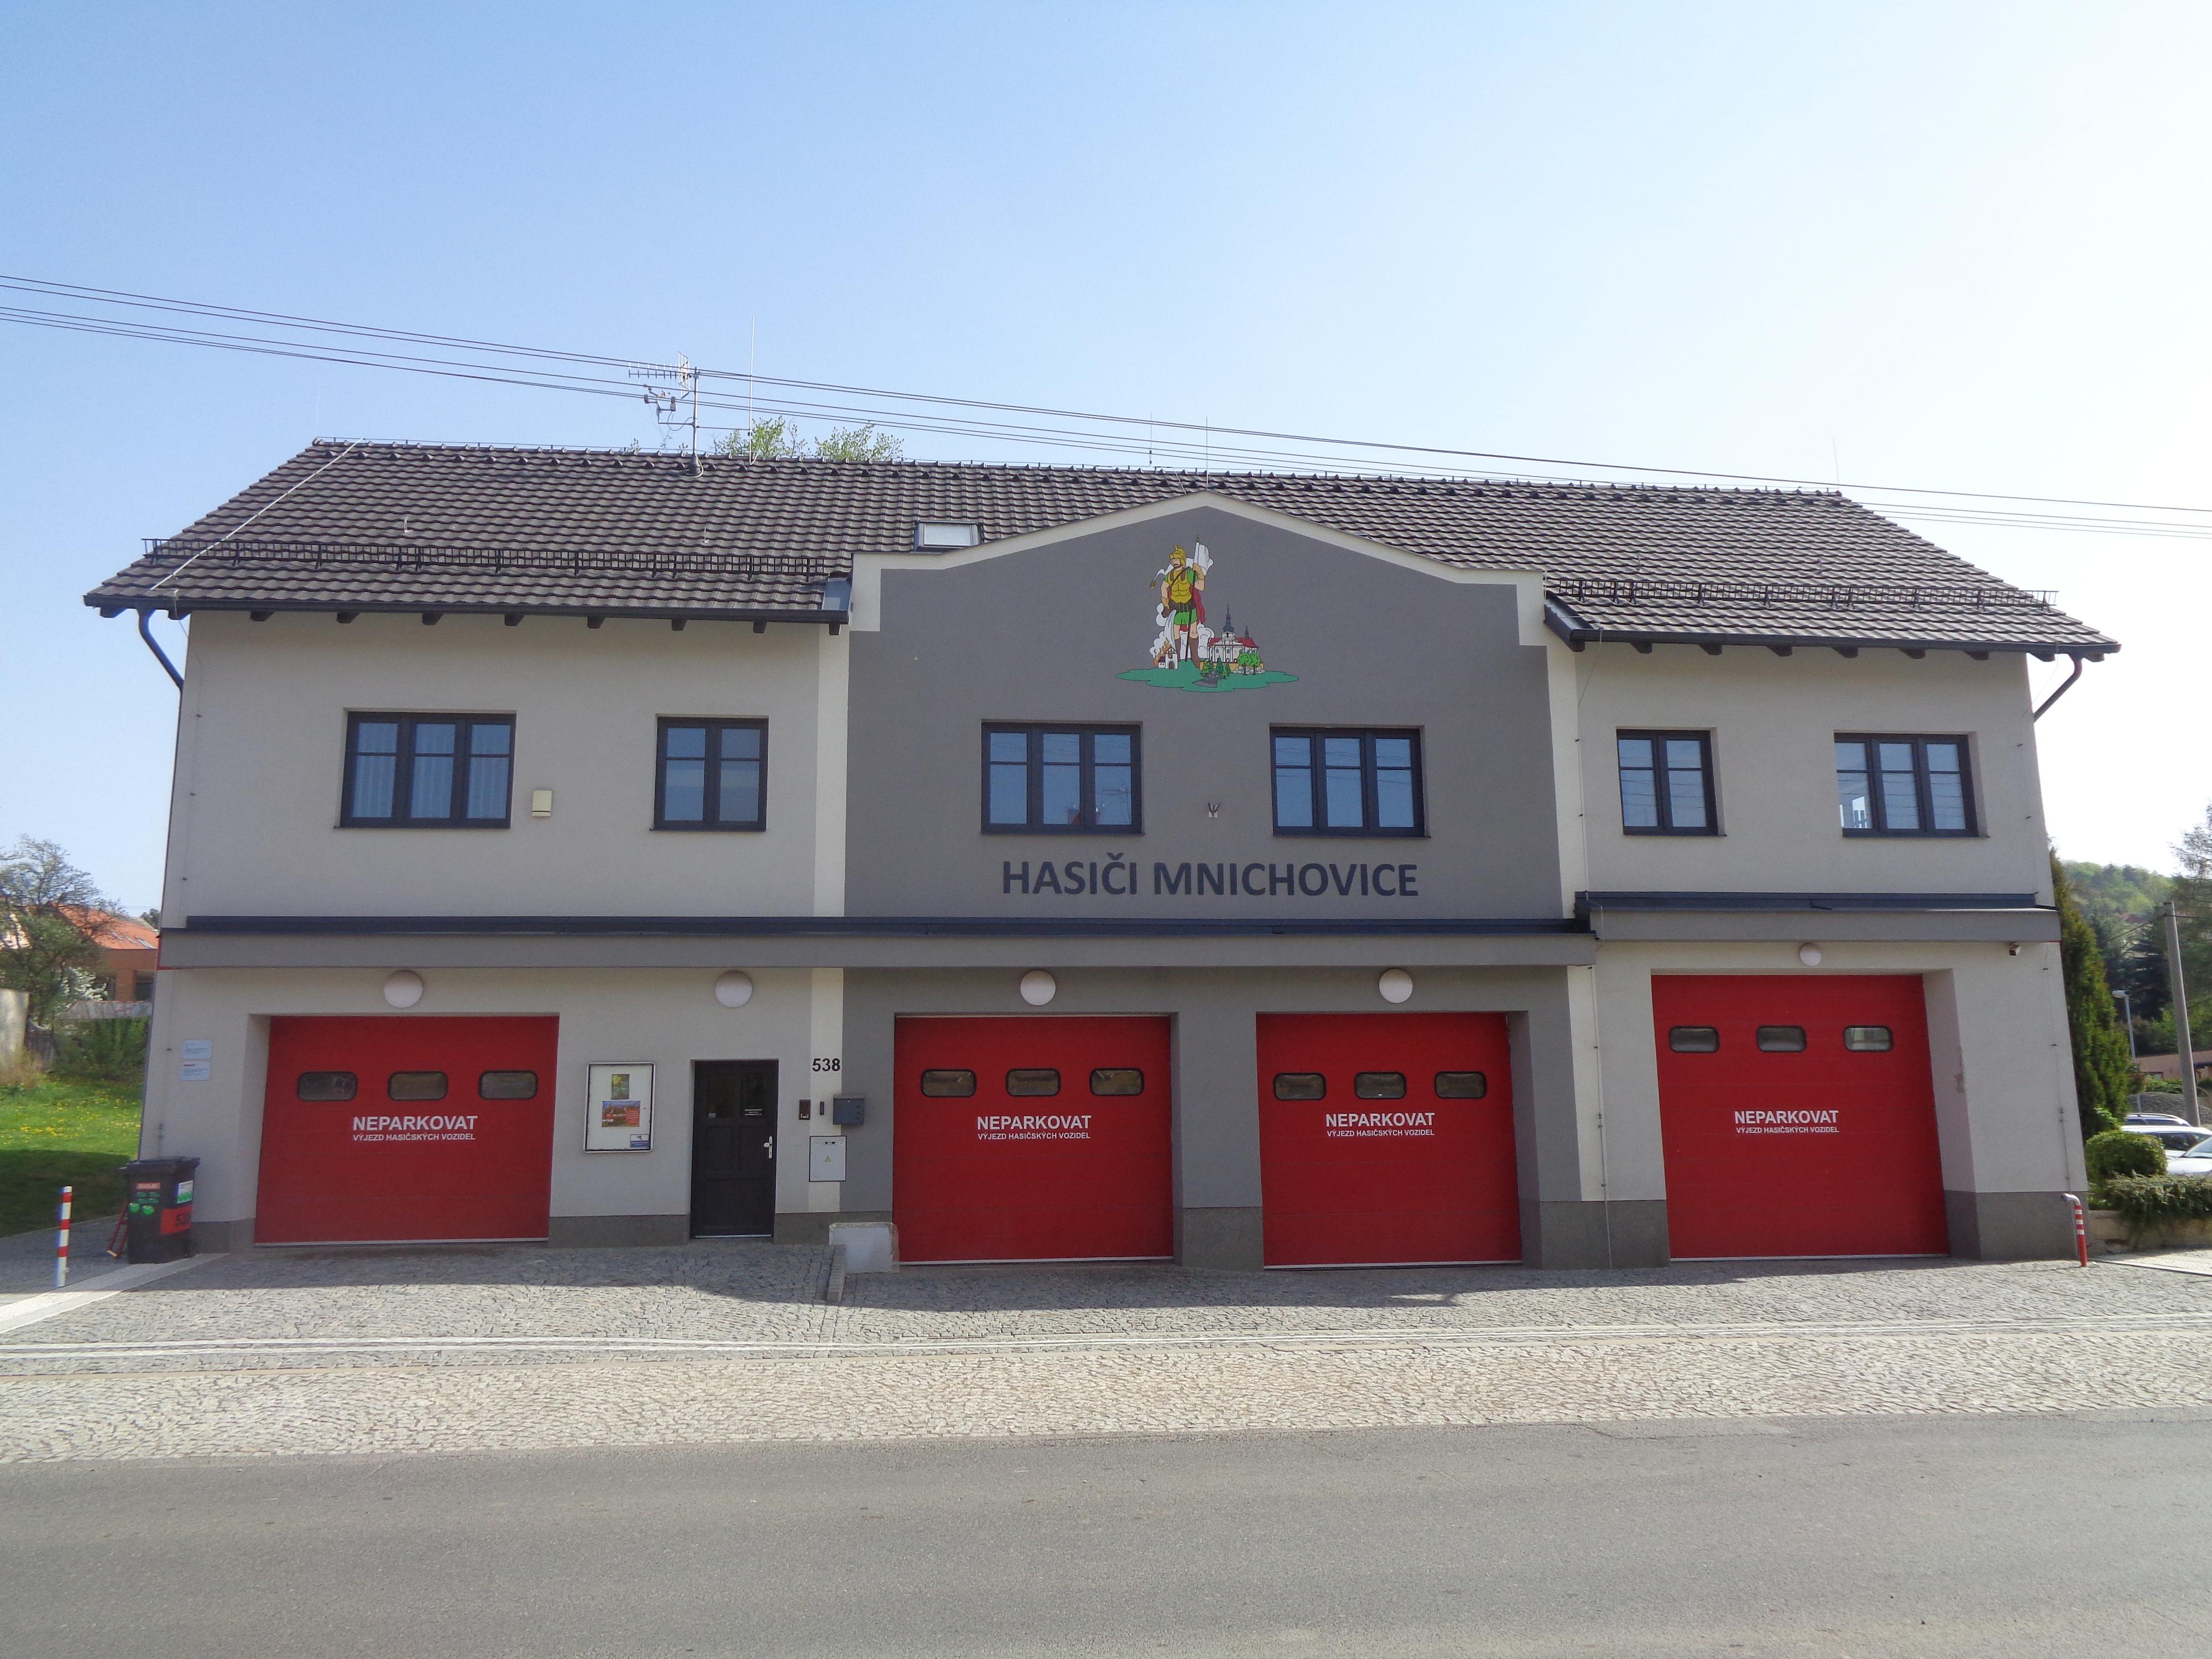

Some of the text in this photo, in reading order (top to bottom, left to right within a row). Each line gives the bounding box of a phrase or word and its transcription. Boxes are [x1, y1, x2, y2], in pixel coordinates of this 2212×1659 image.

[1003, 852, 1419, 896] HASIČI MNICHOVICE
[812, 1058, 841, 1072] 538
[353, 1115, 478, 1130] NEPARKOVAT
[977, 1115, 1092, 1130] NEPARKOVAT
[1326, 1112, 1435, 1127] NEPARKOVAT
[1735, 1110, 1839, 1124] NEPARKOVAT
